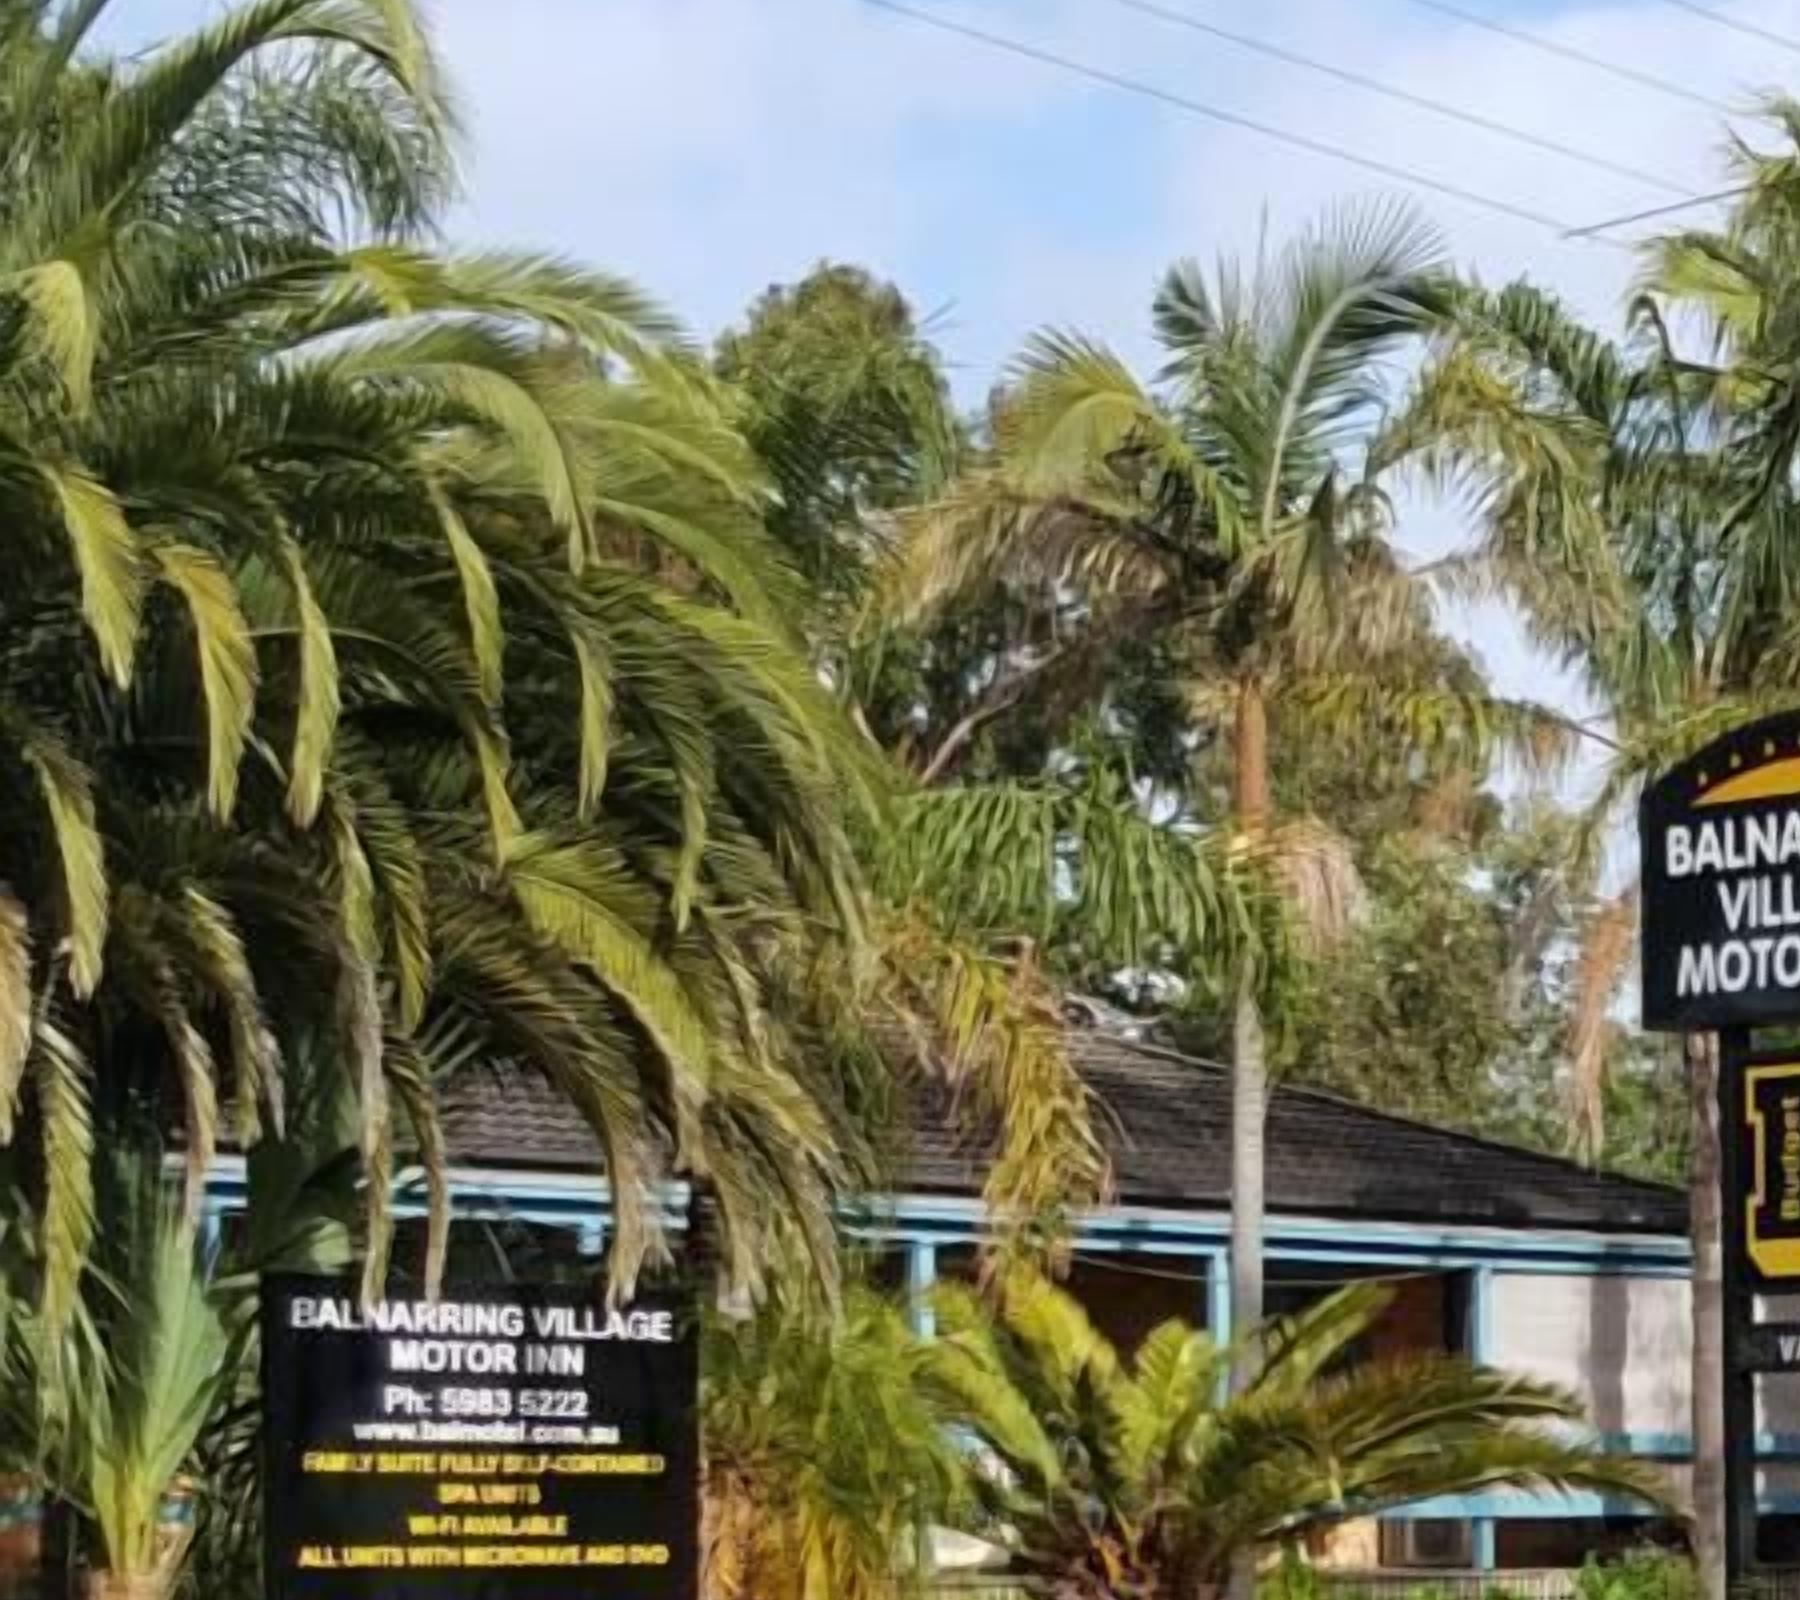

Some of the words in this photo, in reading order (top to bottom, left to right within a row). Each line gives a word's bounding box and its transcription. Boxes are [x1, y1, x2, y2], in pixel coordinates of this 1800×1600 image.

[291, 1297, 525, 1337] BALNARRING
[532, 1306, 672, 1342] VILLAGE
[390, 1340, 516, 1375] MOTOR
[525, 1344, 584, 1376] INN
[384, 1384, 433, 1415] Ph:
[518, 1390, 588, 1417] 5222
